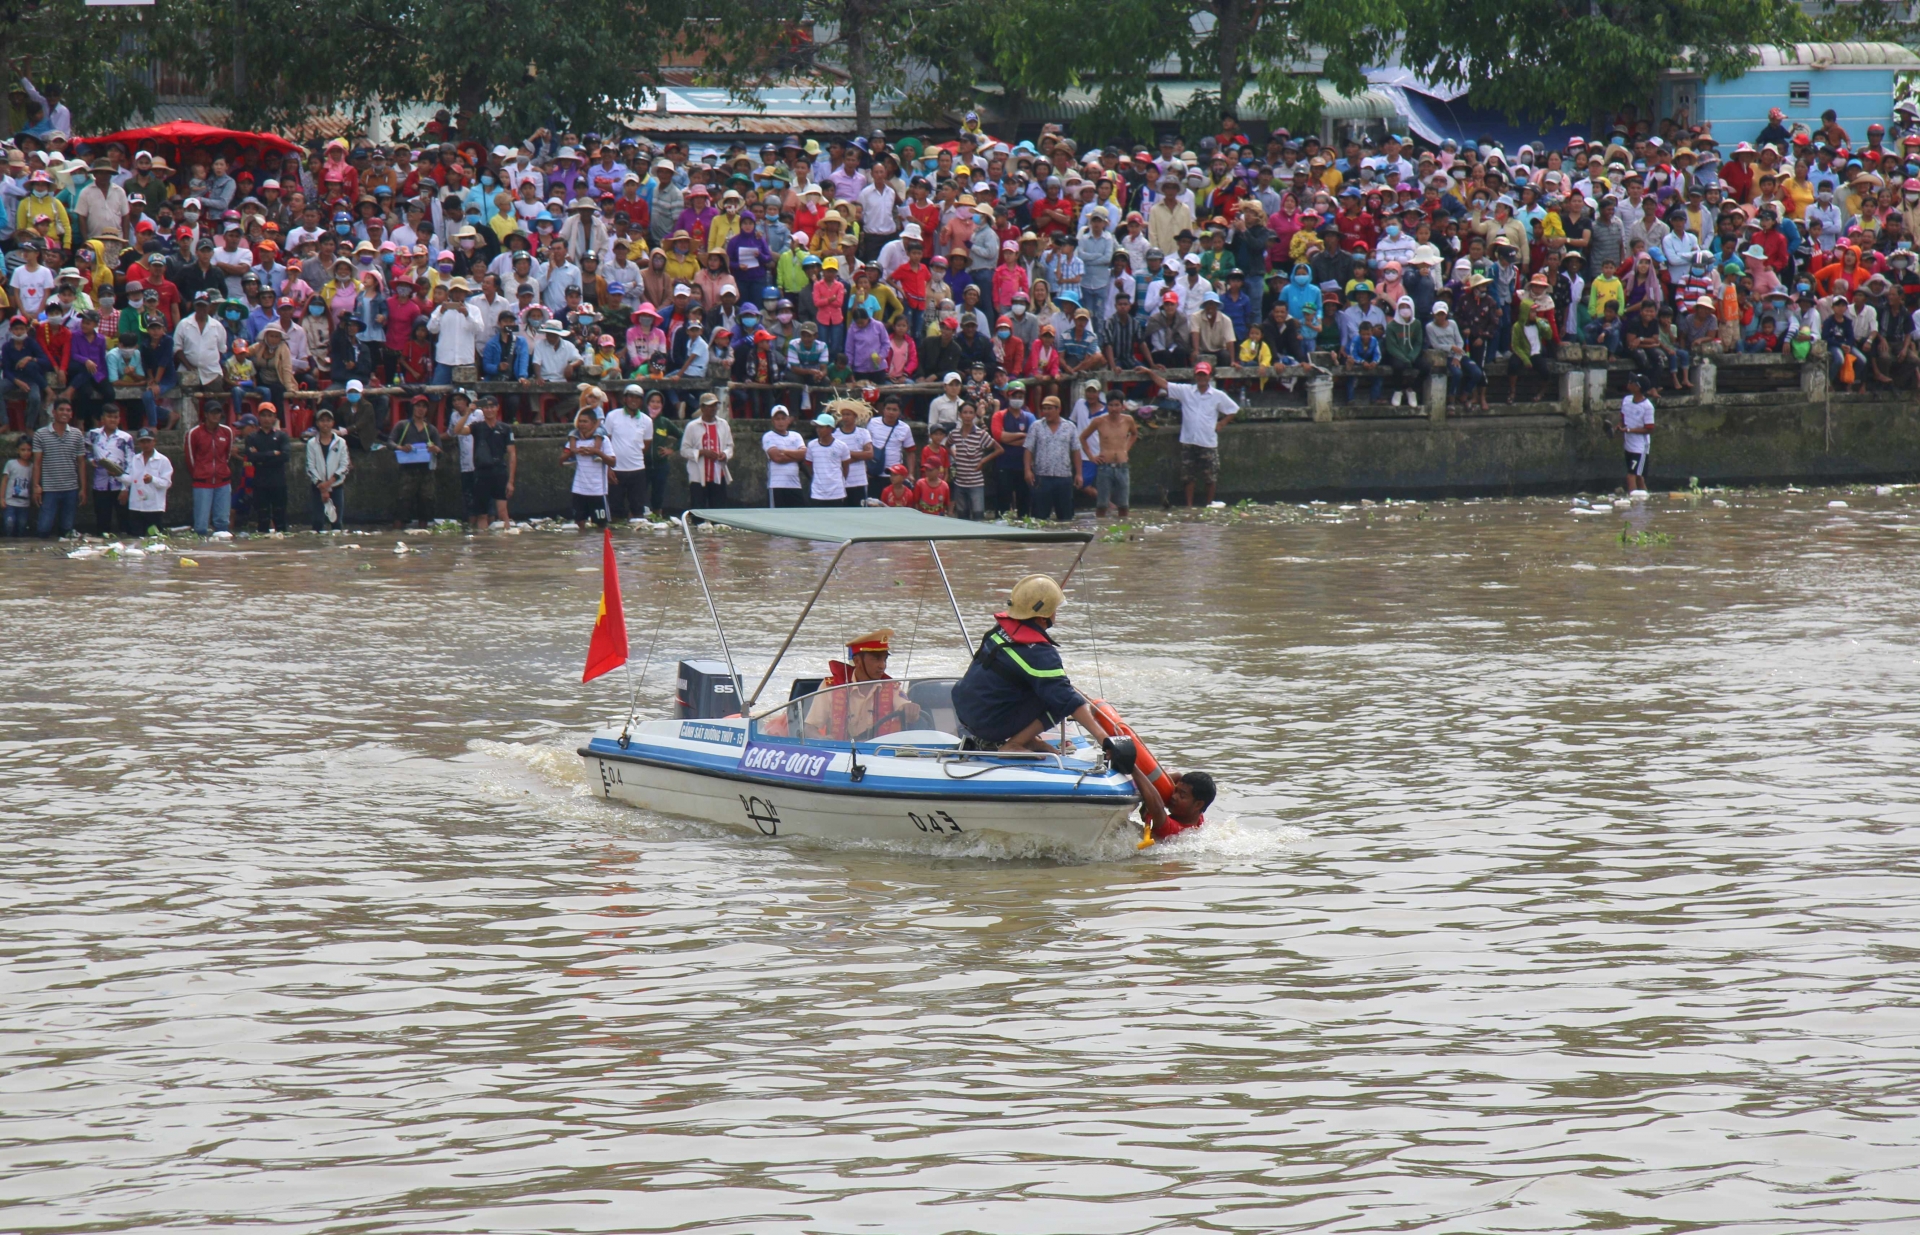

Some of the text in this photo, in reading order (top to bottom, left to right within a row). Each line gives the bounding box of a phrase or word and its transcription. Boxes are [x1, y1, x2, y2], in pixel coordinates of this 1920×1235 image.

[594, 509, 606, 519] 10
[714, 684, 734, 693] 85
[737, 732, 744, 744] 15
[744, 746, 826, 777] CA83-0019
